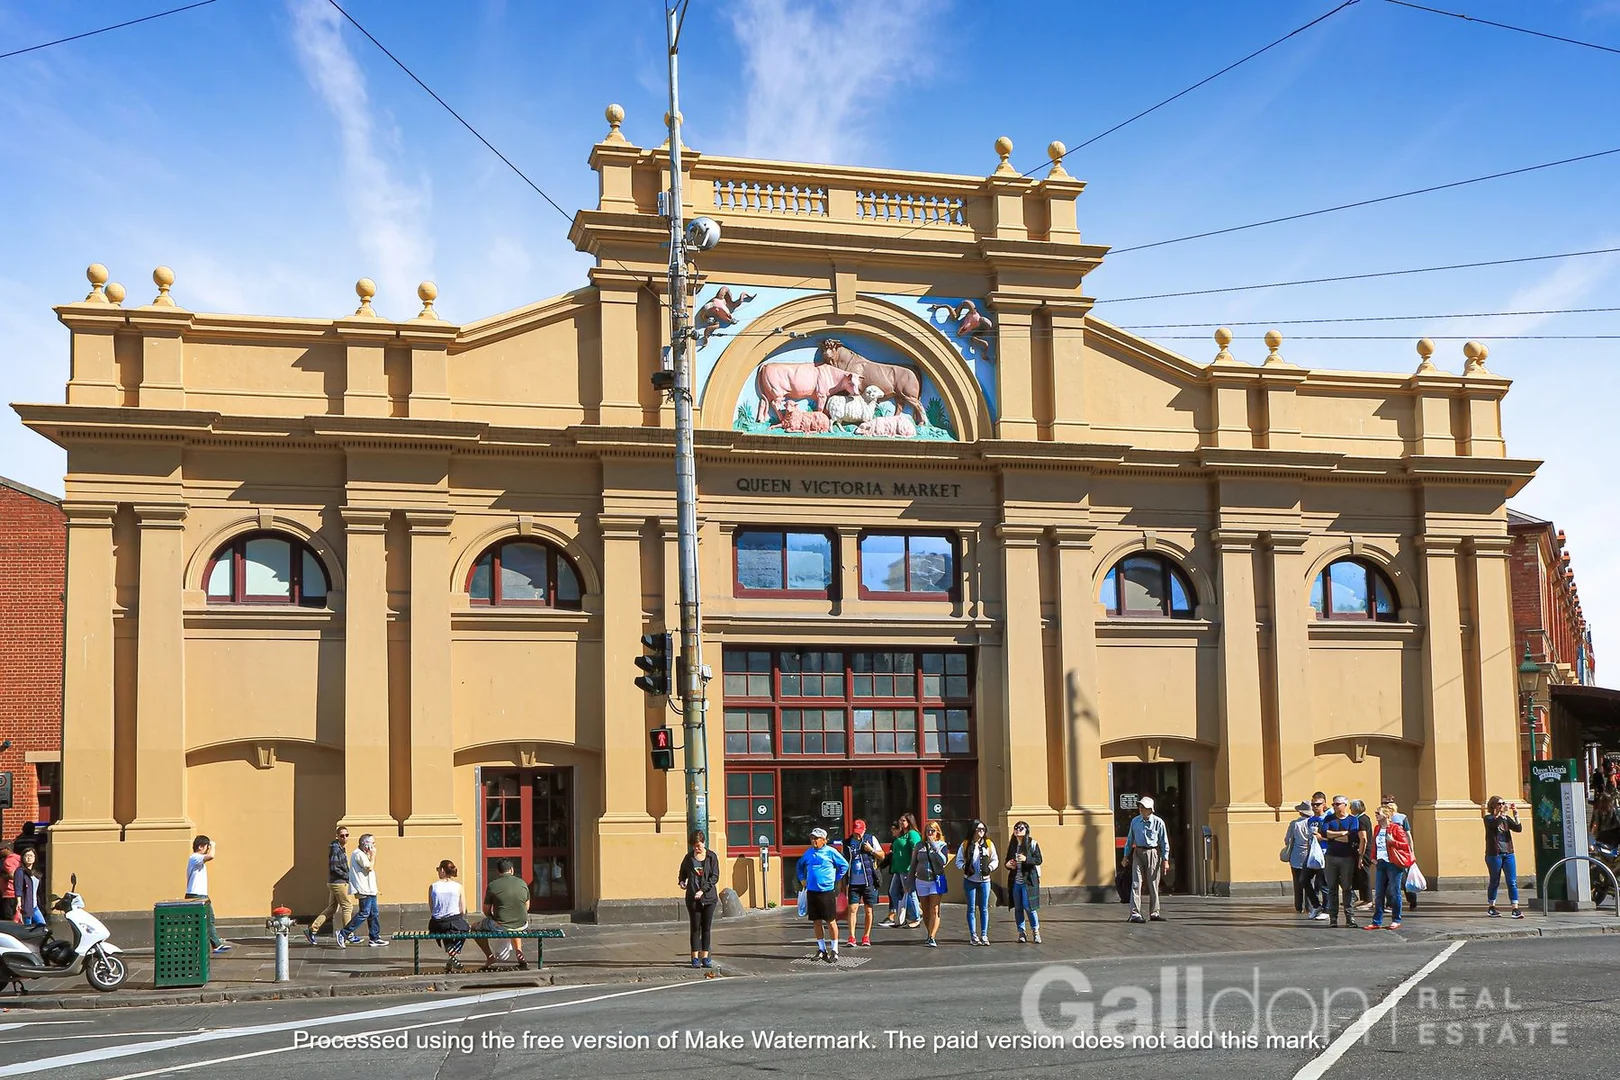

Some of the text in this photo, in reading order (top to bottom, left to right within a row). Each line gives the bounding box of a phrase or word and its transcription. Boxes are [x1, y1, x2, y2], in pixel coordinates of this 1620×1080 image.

[736, 477, 961, 498] QUEEN VICTORIA MARKET
